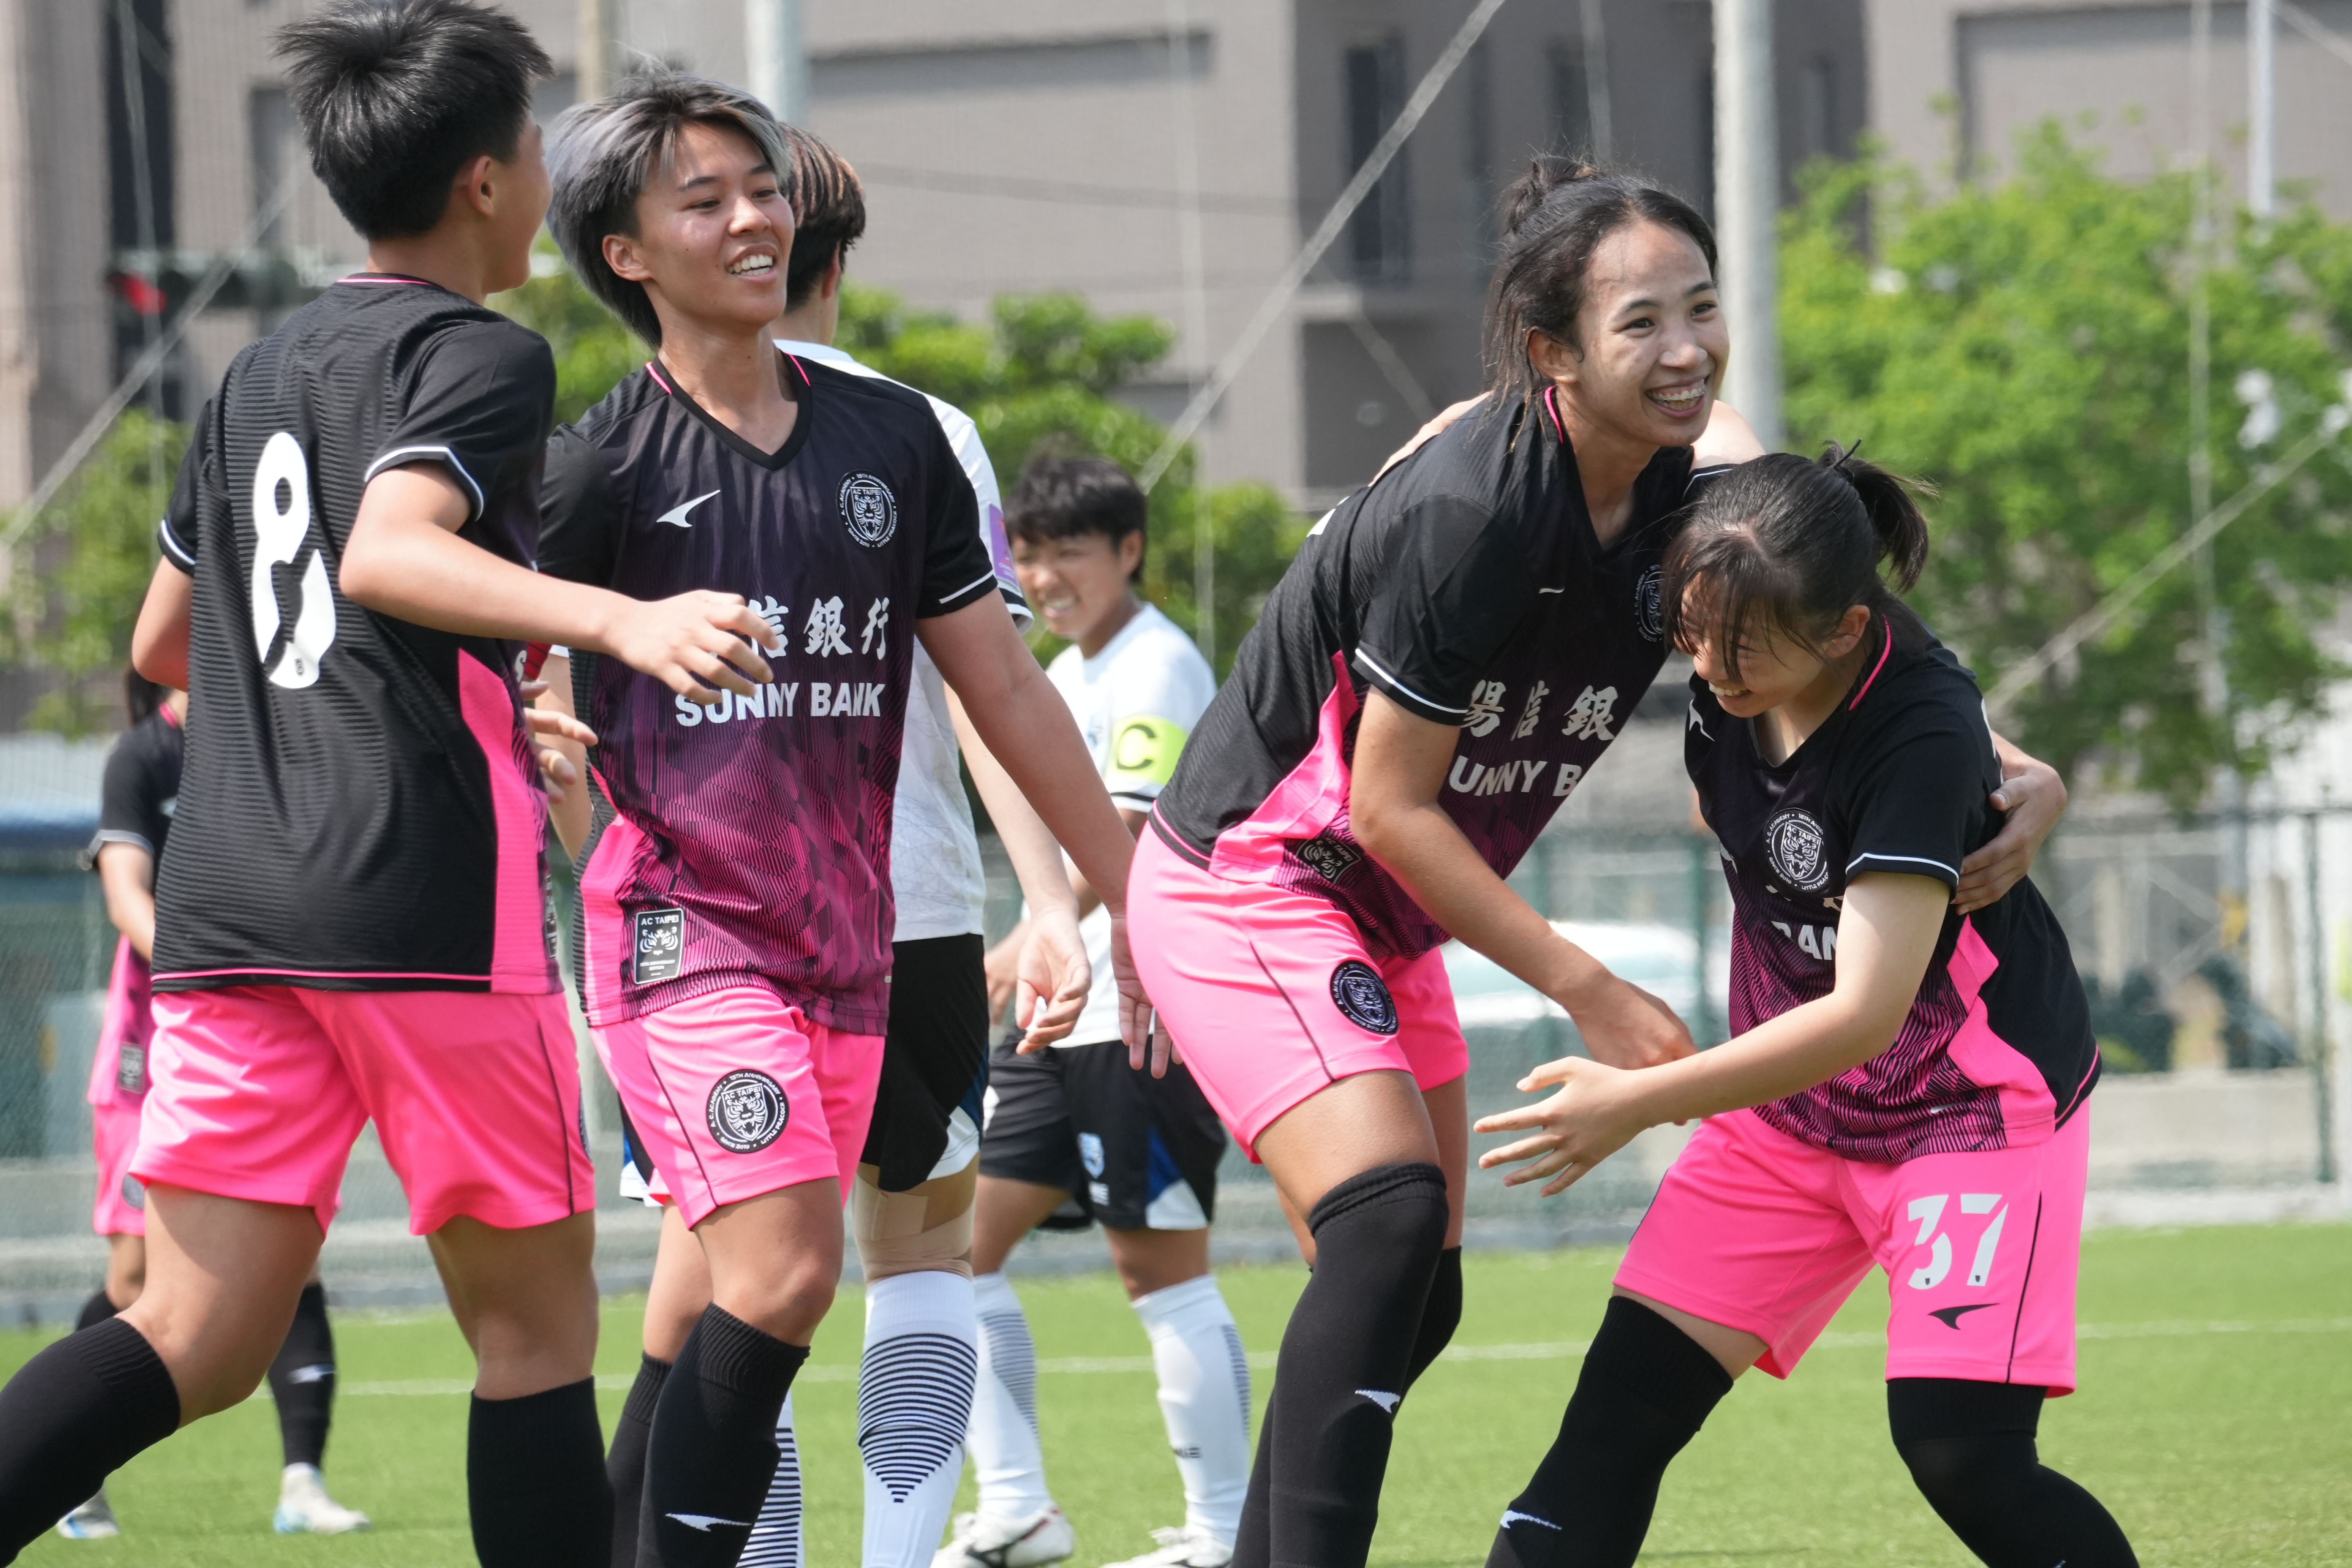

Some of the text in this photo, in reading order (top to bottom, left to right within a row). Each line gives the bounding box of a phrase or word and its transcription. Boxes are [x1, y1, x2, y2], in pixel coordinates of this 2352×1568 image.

[252, 432, 336, 689] 8
[709, 595, 890, 660] 信銀行
[675, 682, 885, 727] SUNNY BANK
[1461, 679, 1618, 741] 陽信銀
[1116, 724, 1156, 770] C
[1448, 755, 1548, 797] UNNY
[1769, 813, 1790, 831] ACADEMY
[1799, 813, 1811, 822] 15TH
[1799, 831, 1819, 845] TAIPEI
[1779, 873, 1792, 884] 2010
[655, 915, 679, 925] TAIPEI
[737, 1086, 761, 1095] TAIPEI
[744, 1073, 781, 1094] ANNIVERSARY
[709, 1084, 723, 1113] ACADEMY
[760, 1102, 786, 1144] LITTLE PEACOCK
[721, 1136, 735, 1148] SINCE
[1908, 1193, 2009, 1290] 37
